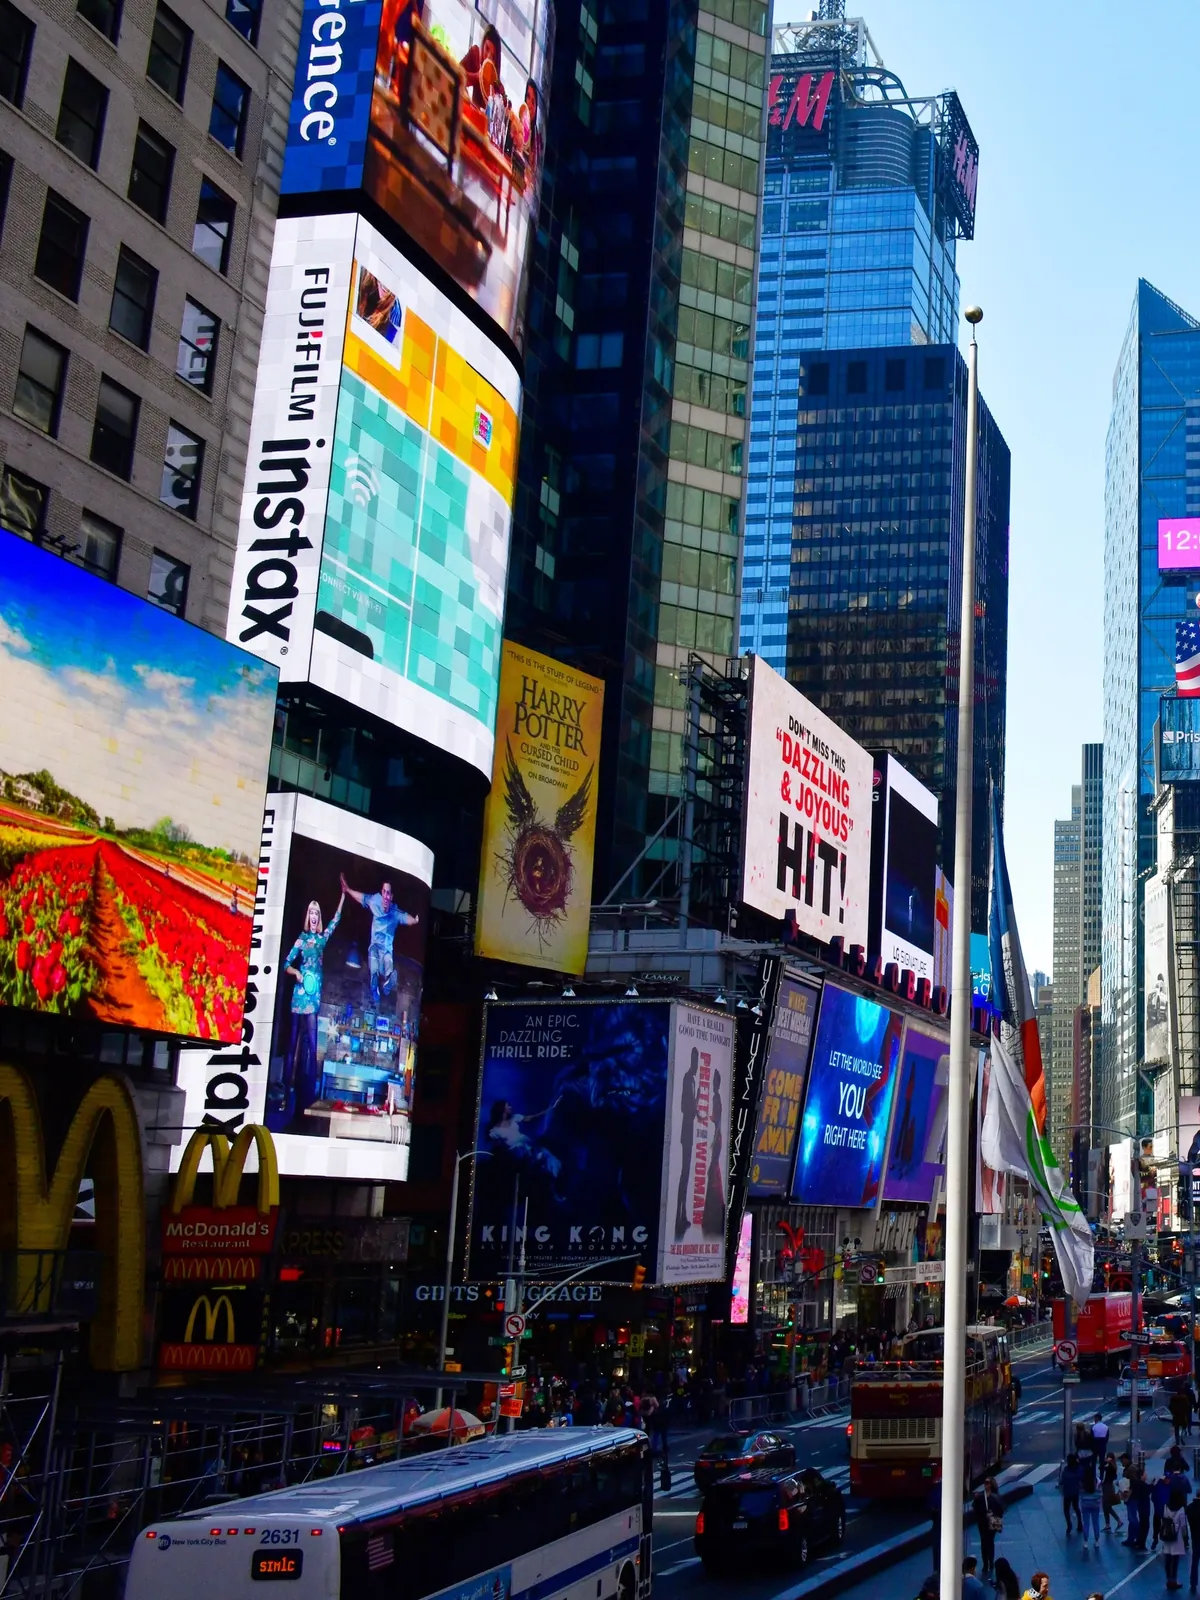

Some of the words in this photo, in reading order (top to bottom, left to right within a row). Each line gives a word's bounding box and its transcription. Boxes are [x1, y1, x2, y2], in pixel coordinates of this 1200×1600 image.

[288, 267, 329, 421] FUJIFILM
[518, 675, 587, 727] HARRY
[513, 701, 588, 757] POTTER
[788, 714, 811, 745] DON'T
[812, 734, 829, 761] MISS
[830, 749, 846, 773] THIS
[520, 742, 552, 762] CURSED
[553, 754, 579, 773] CHILD
[780, 770, 791, 805] &
[776, 811, 847, 925] HIT!
[548, 1014, 580, 1028] EPIC,
[490, 1045, 532, 1058] THRILL
[500, 1030, 562, 1043] DAZZLING
[829, 1050, 841, 1067] LET
[841, 1053, 853, 1071] THE
[853, 1057, 872, 1077] WORLD
[872, 1063, 883, 1079] SEE
[768, 1068, 803, 1102] COME
[838, 1081, 867, 1119] YOU
[757, 1125, 794, 1155] AWAY
[823, 1124, 848, 1146] RIGHT
[847, 1128, 867, 1150] HERE
[166, 1221, 269, 1236] McDonald's
[481, 1225, 551, 1243] KING
[182, 1240, 251, 1248] Restaurant
[260, 1529, 300, 1544] 2631
